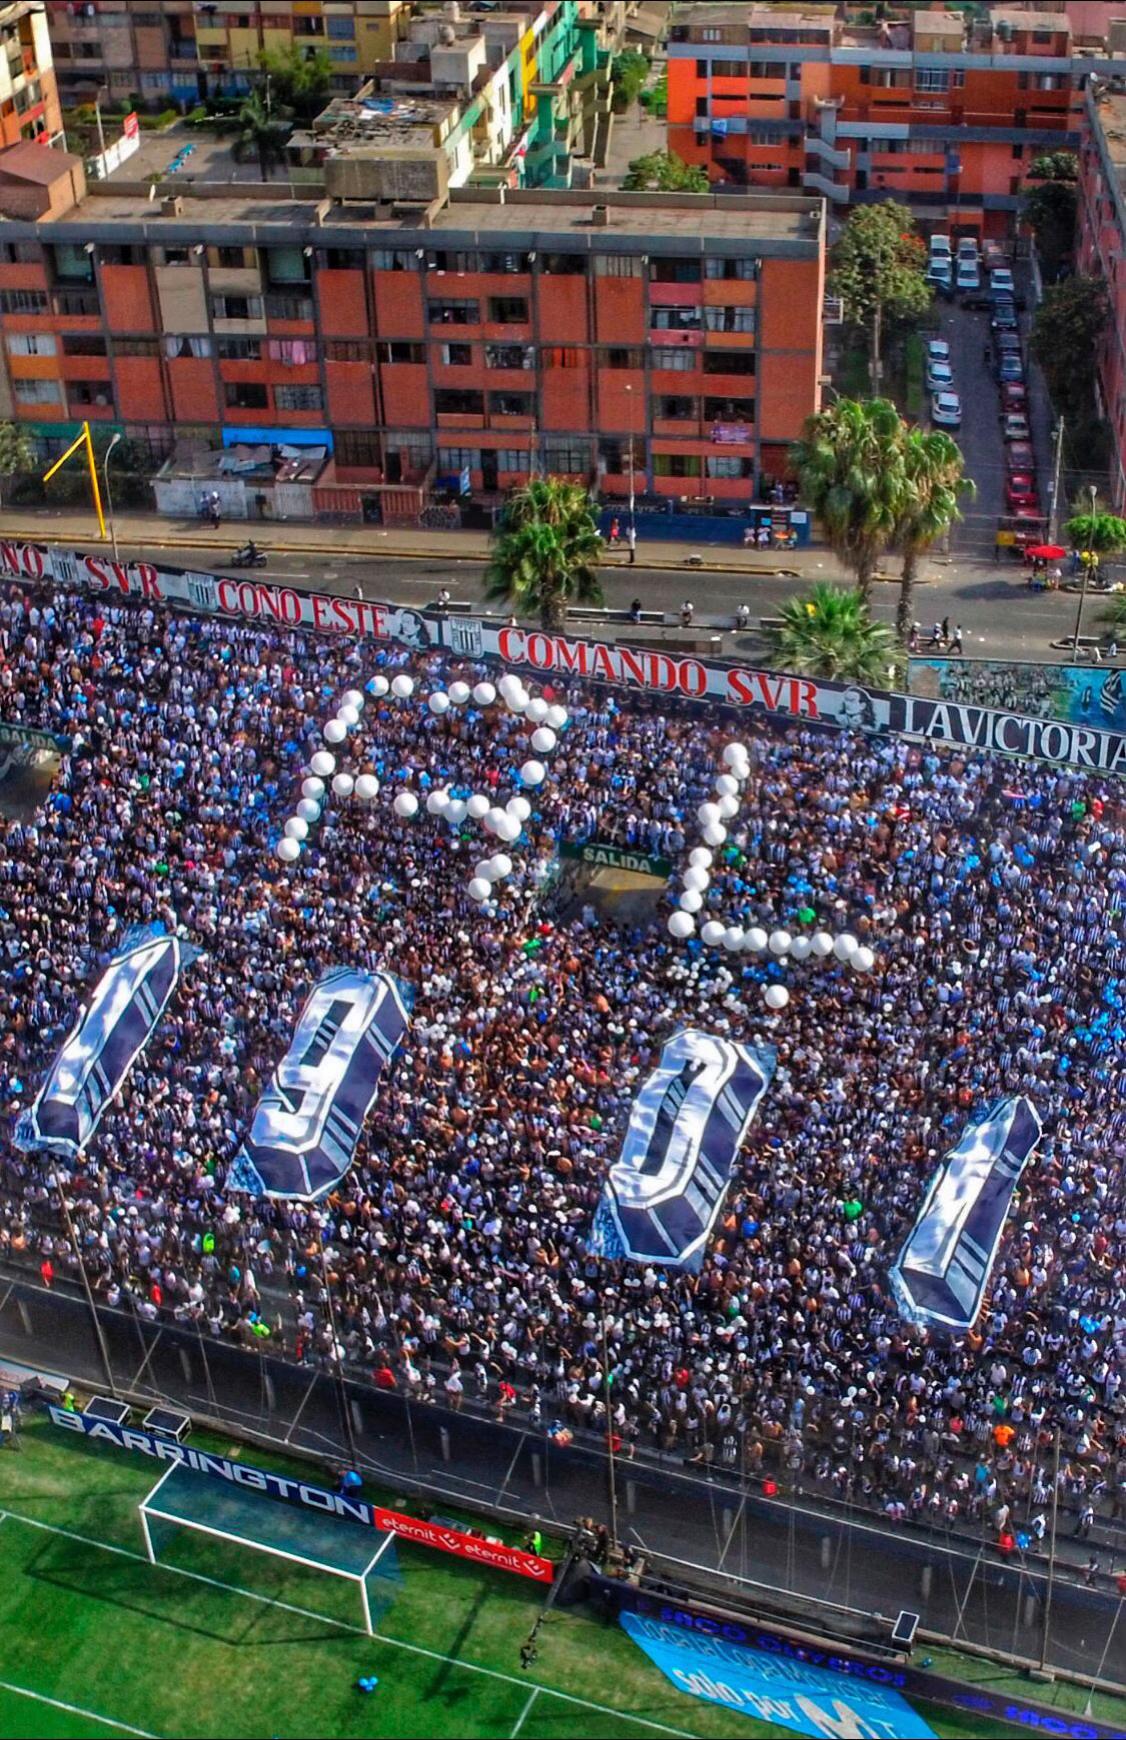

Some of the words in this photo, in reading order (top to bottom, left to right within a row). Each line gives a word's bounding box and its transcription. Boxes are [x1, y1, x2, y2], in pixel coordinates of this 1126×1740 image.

[82, 553, 166, 600] SVR
[217, 578, 302, 627] CONO
[309, 593, 393, 641] ESTE
[498, 627, 708, 698] COMANDO
[725, 668, 822, 720] SVR
[903, 699, 954, 741] LA
[583, 847, 652, 873] SALIDA
[51, 1409, 370, 1525] BARRINGTON
[382, 1517, 437, 1543] eternit
[464, 1542, 521, 1569] eternit
[672, 1667, 745, 1707] solo
[739, 1688, 800, 1723] por
